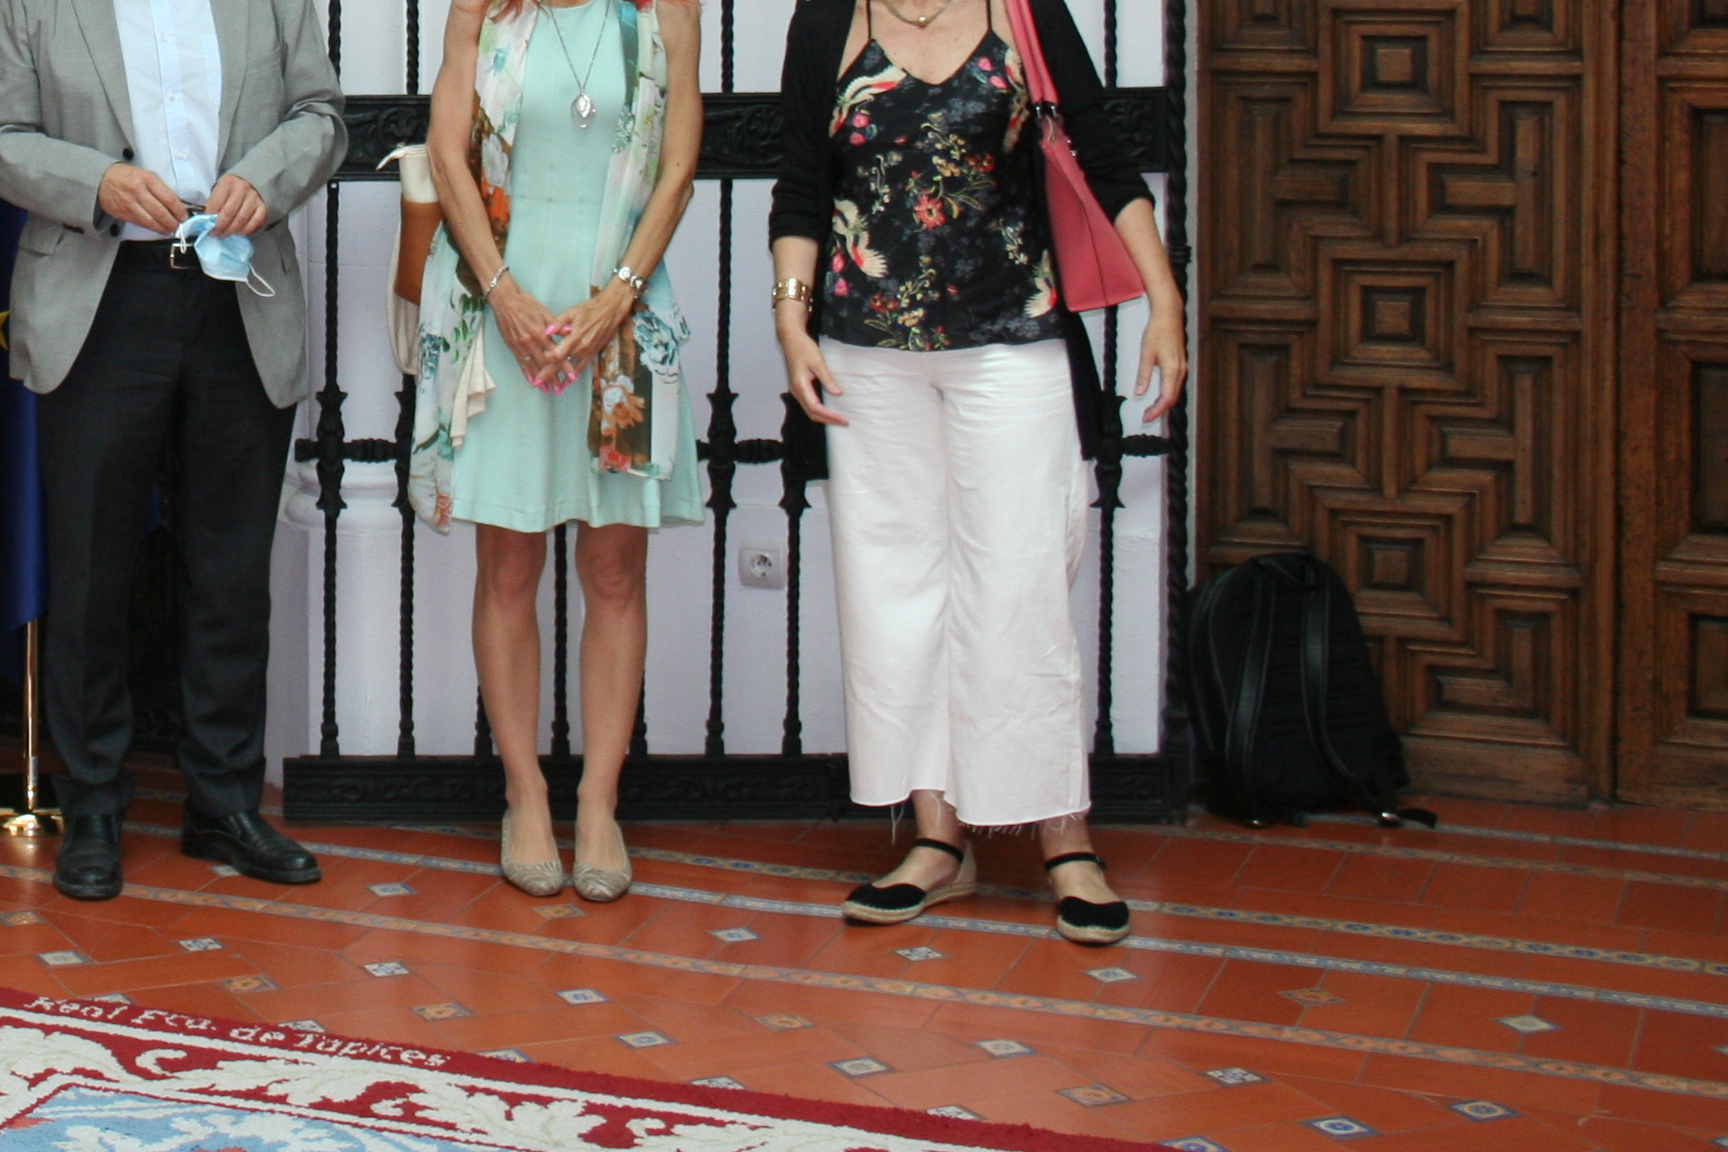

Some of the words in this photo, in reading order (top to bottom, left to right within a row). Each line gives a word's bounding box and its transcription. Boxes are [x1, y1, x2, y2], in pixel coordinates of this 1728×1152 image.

[23, 996, 129, 1020] Real
[229, 1025, 286, 1043] de
[292, 1032, 451, 1066] Tapices
